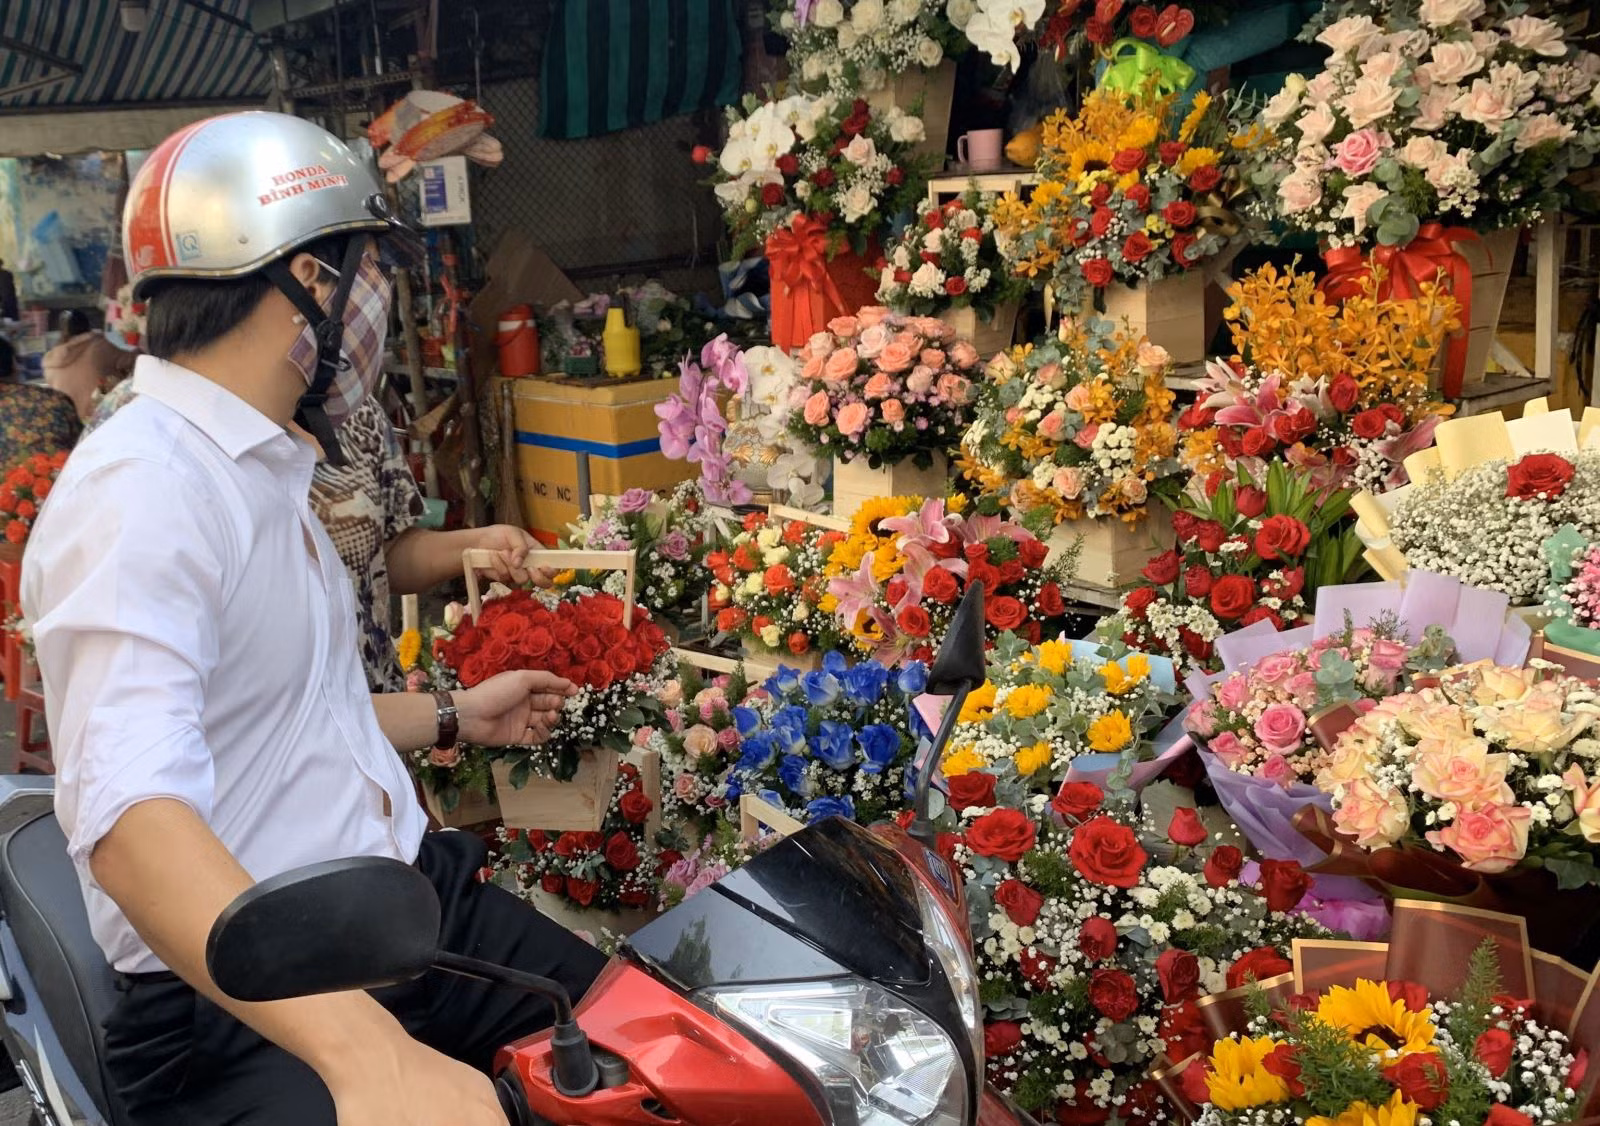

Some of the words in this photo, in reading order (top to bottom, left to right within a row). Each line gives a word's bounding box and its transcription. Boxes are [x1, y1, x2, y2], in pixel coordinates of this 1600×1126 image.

[272, 164, 328, 186] HONDA
[533, 481, 547, 497] NC
[556, 486, 571, 502] NC
